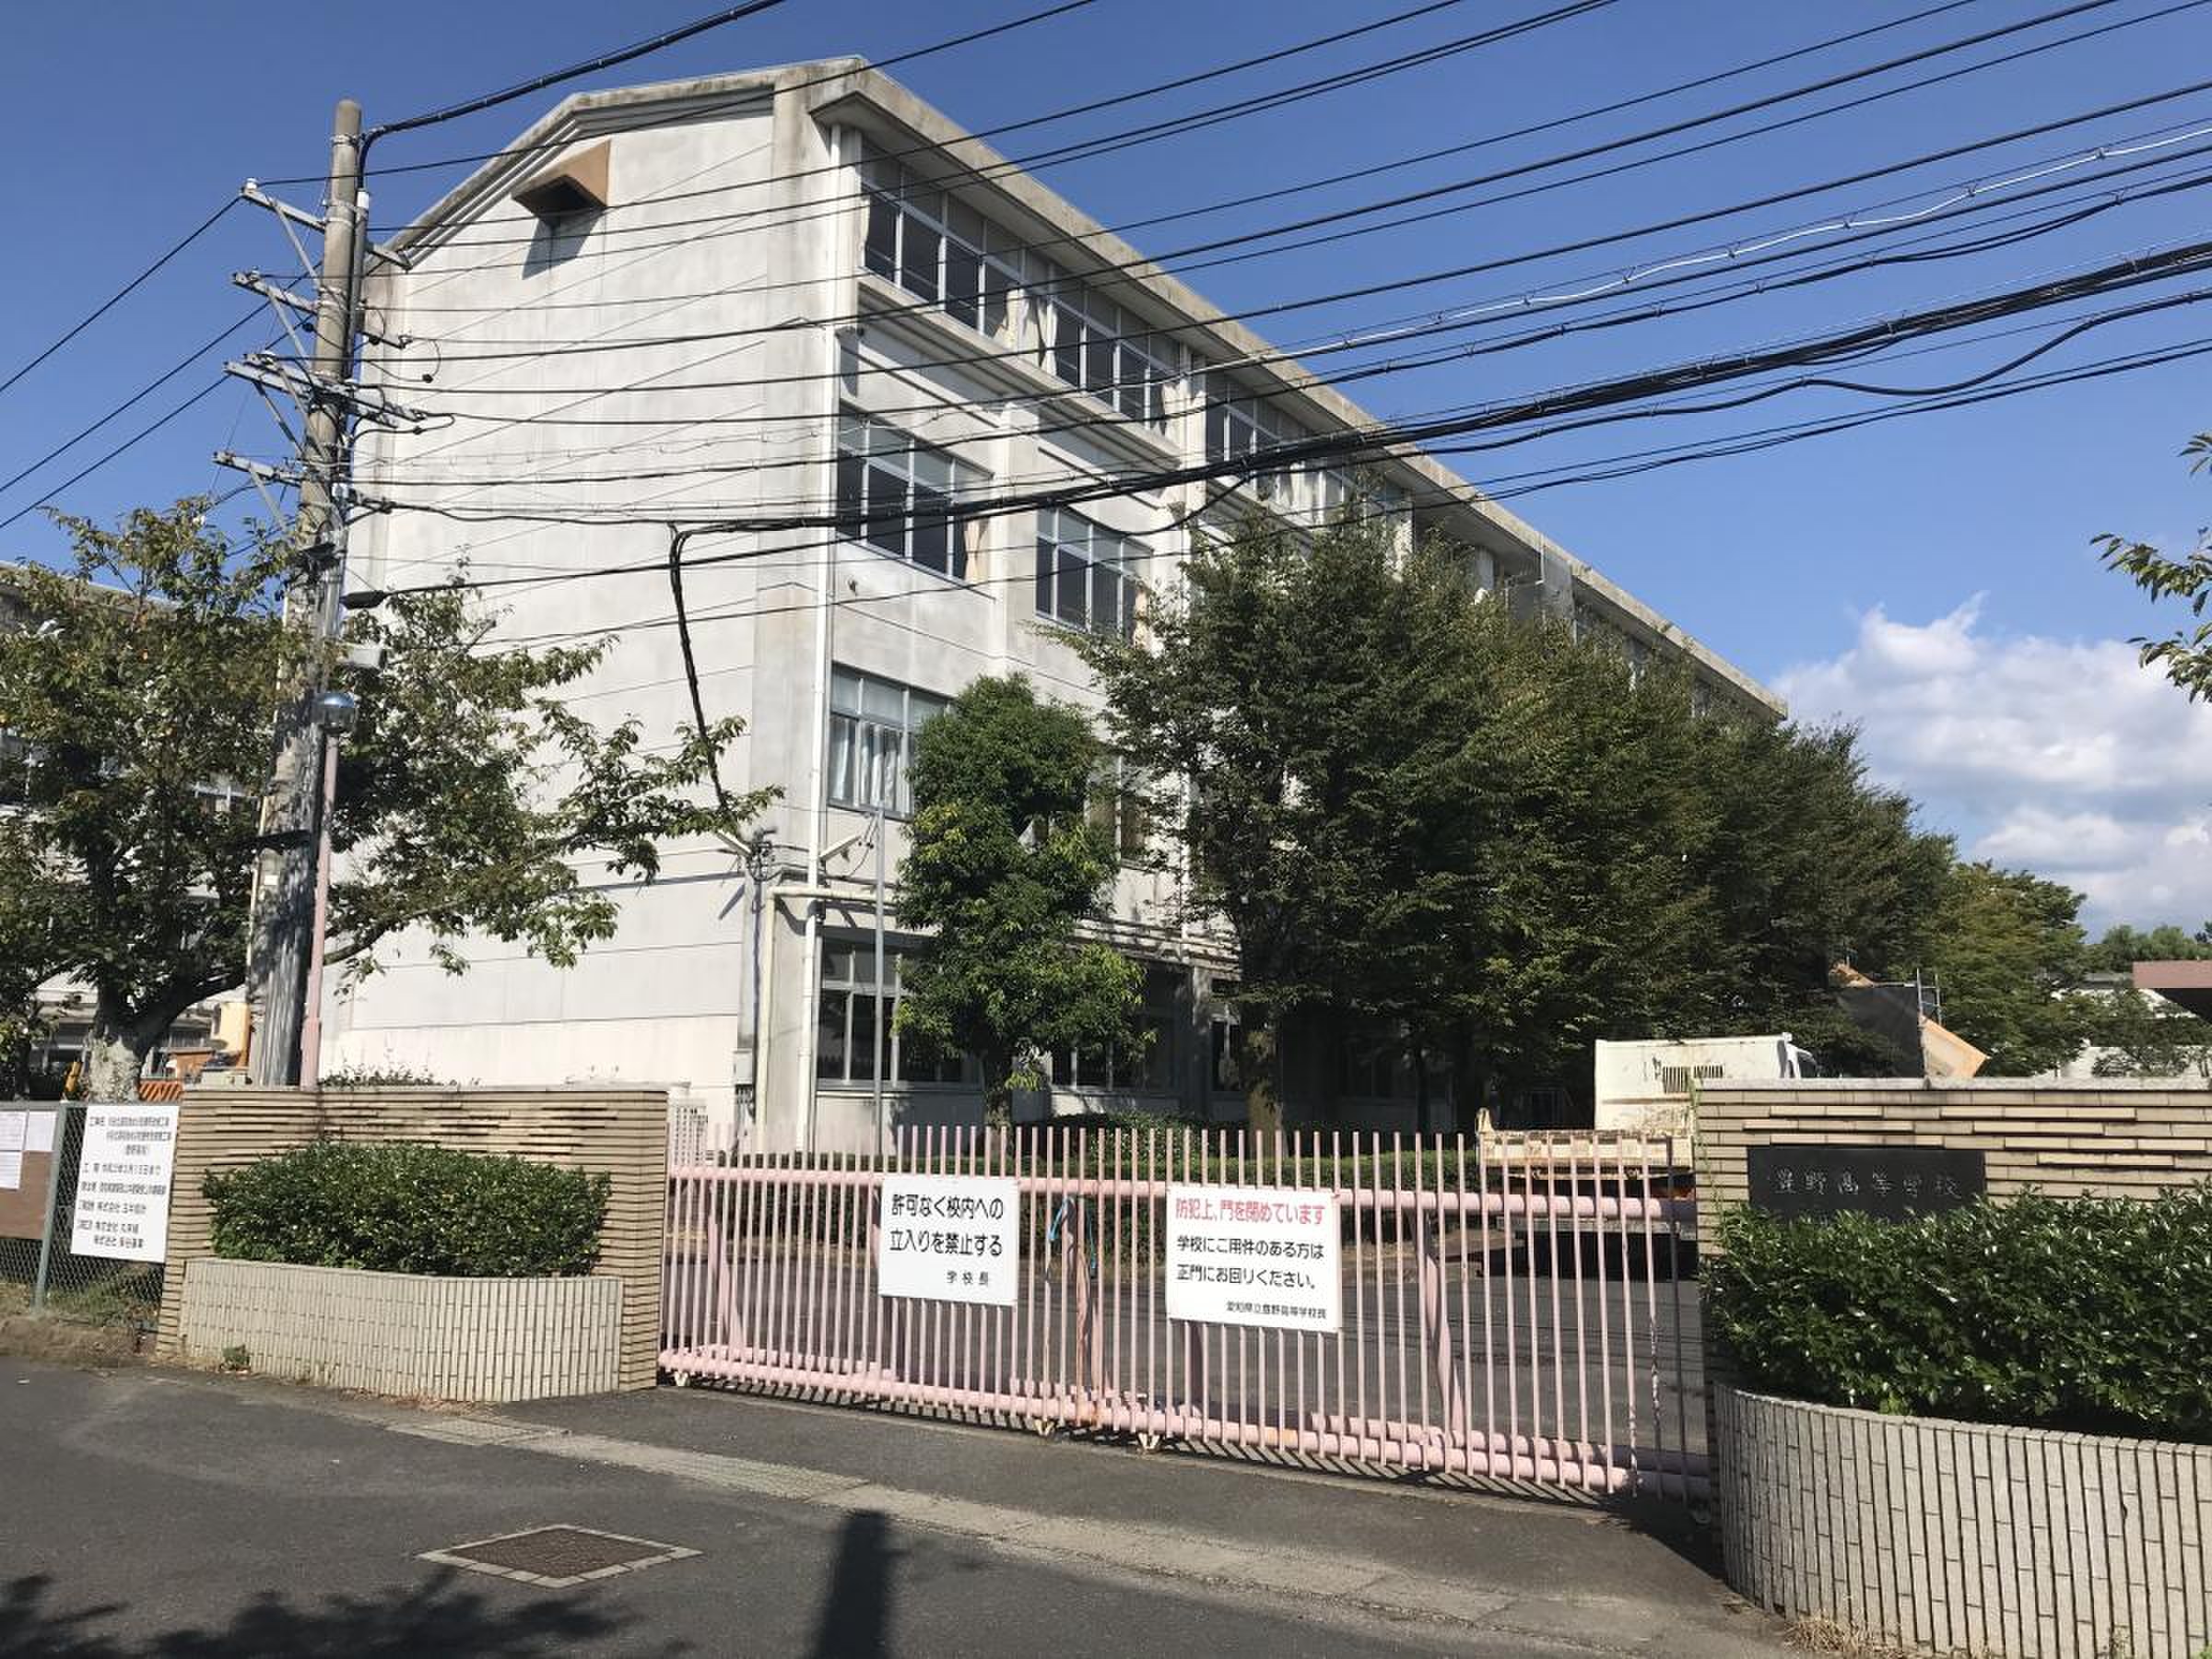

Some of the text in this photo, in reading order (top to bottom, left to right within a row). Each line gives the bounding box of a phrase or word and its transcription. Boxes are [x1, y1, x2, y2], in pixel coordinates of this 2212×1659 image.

[891, 1194, 1004, 1220] 許可なく校内への
[1175, 1197, 1326, 1225] 防犯上、門を閉めています
[889, 1229, 1003, 1257] 立入りを禁止する
[1177, 1234, 1324, 1260] 学校にご用件のある方は
[1177, 1263, 1316, 1289] 正門にお回りください。
